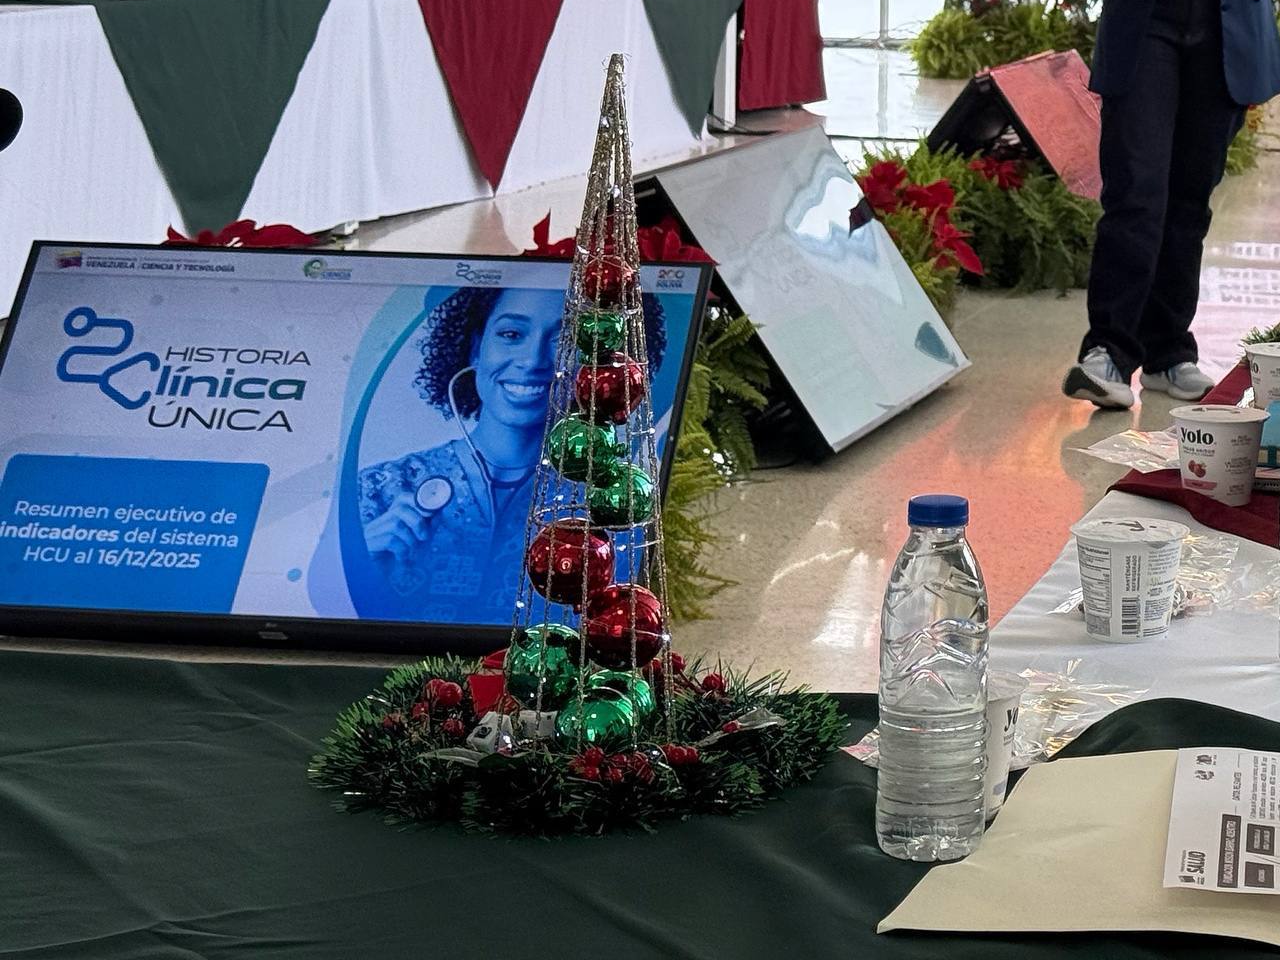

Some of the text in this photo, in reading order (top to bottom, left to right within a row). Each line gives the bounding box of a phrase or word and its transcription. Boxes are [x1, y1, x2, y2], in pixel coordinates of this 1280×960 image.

[86, 260, 135, 269] VENEZUELA
[142, 262, 173, 270] CIENCIA
[184, 263, 235, 272] TECNOLOGÍA
[165, 345, 312, 366] HISTORIA
[147, 400, 294, 433] ÚNICA
[14, 500, 238, 525] Resumen ejecutivo de
[0, 521, 239, 548] indicadores del sistema
[23, 546, 202, 569] HCU al 16/12/2025
[1186, 850, 1206, 875] SALUD
